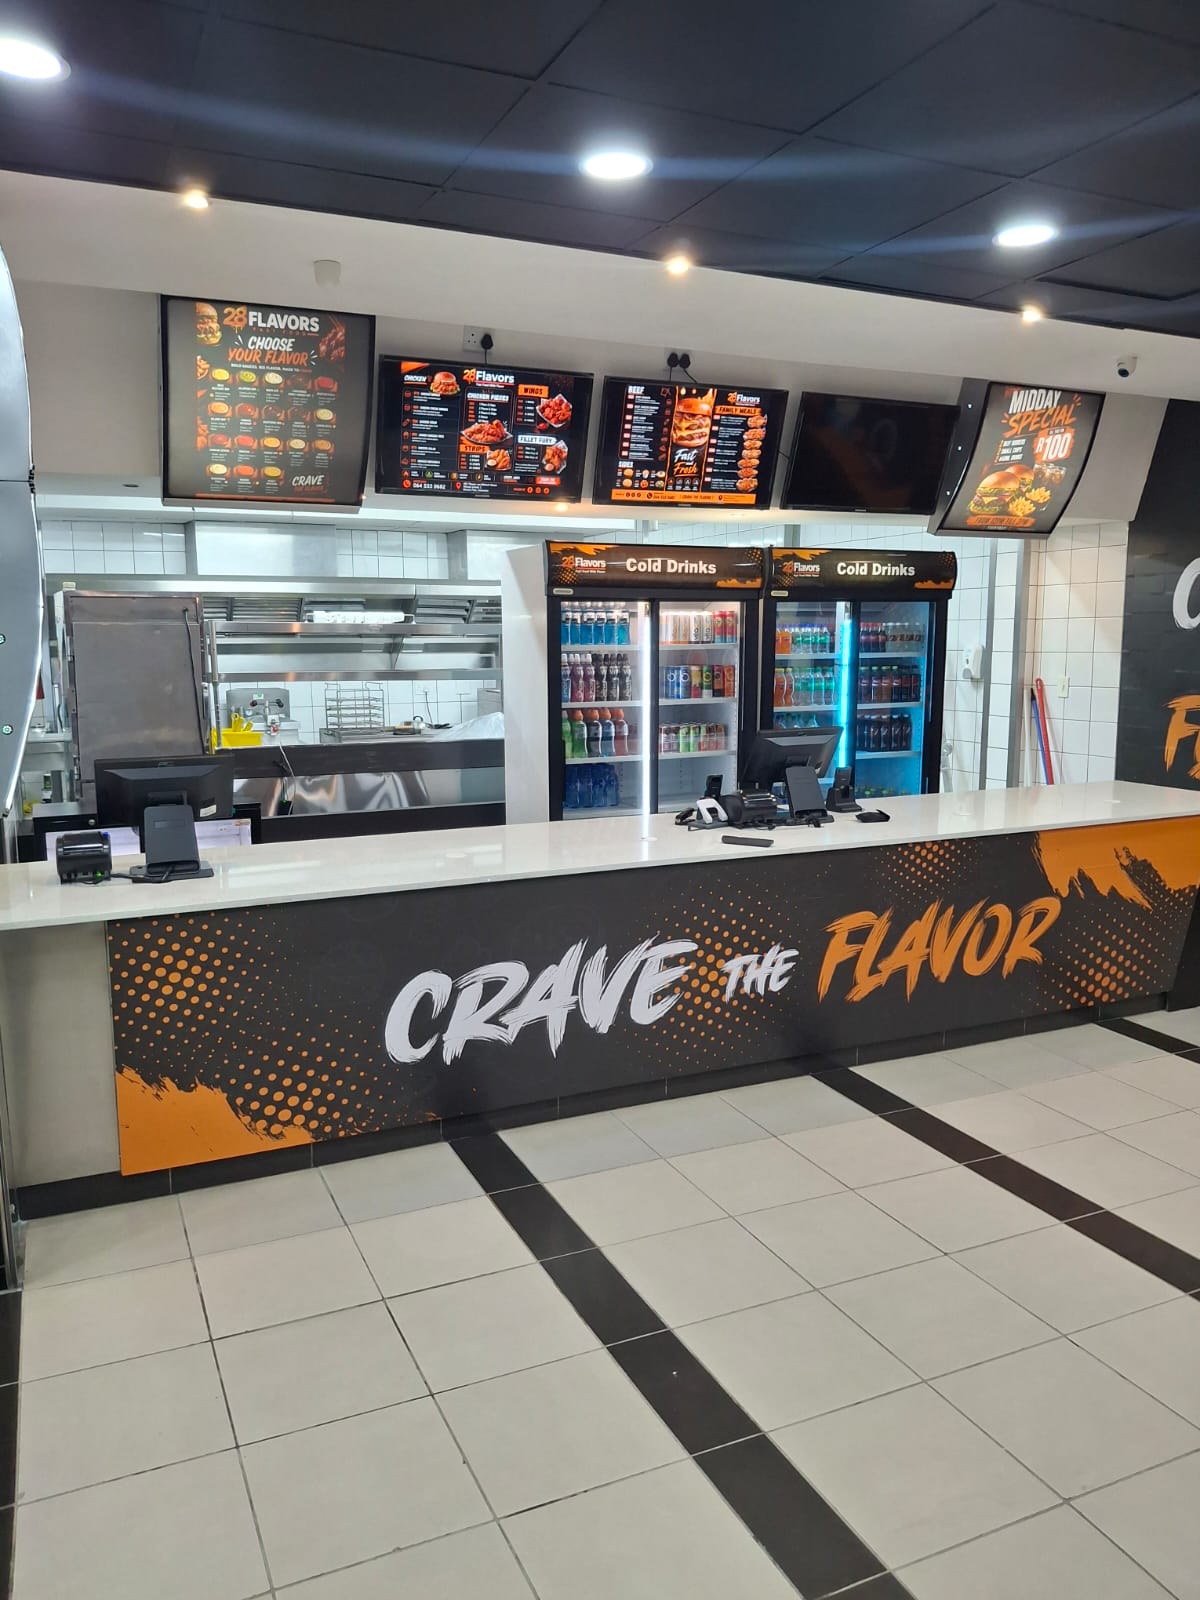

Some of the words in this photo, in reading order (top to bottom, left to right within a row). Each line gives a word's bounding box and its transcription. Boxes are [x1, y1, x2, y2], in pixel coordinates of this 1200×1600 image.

[223, 304, 247, 328] 28
[248, 311, 320, 332] FLAVORS
[247, 335, 296, 352] CHOOSE
[227, 347, 262, 364] YOUR
[264, 350, 309, 367] FLAVOR
[463, 368, 476, 383] 28
[476, 370, 515, 384] Flavors
[523, 387, 543, 395] WINGS
[737, 393, 760, 403] Flavors
[1008, 388, 1062, 415] MIDDAY
[1002, 403, 1077, 438] SPECIAL
[1034, 432, 1072, 461] R100
[674, 448, 699, 463] Fast
[673, 461, 698, 475] Fresh
[291, 474, 325, 487] CRAVE
[562, 555, 575, 569] 28
[575, 557, 606, 568] Flavors
[626, 558, 662, 573] Cold
[666, 559, 717, 575] Drinks
[793, 562, 820, 572] Flavors
[836, 562, 868, 576] Cold
[871, 562, 916, 577] Drinks
[384, 936, 699, 1066] CRAVE
[720, 942, 800, 1003] THE
[817, 896, 1062, 1004] FLAVOR
